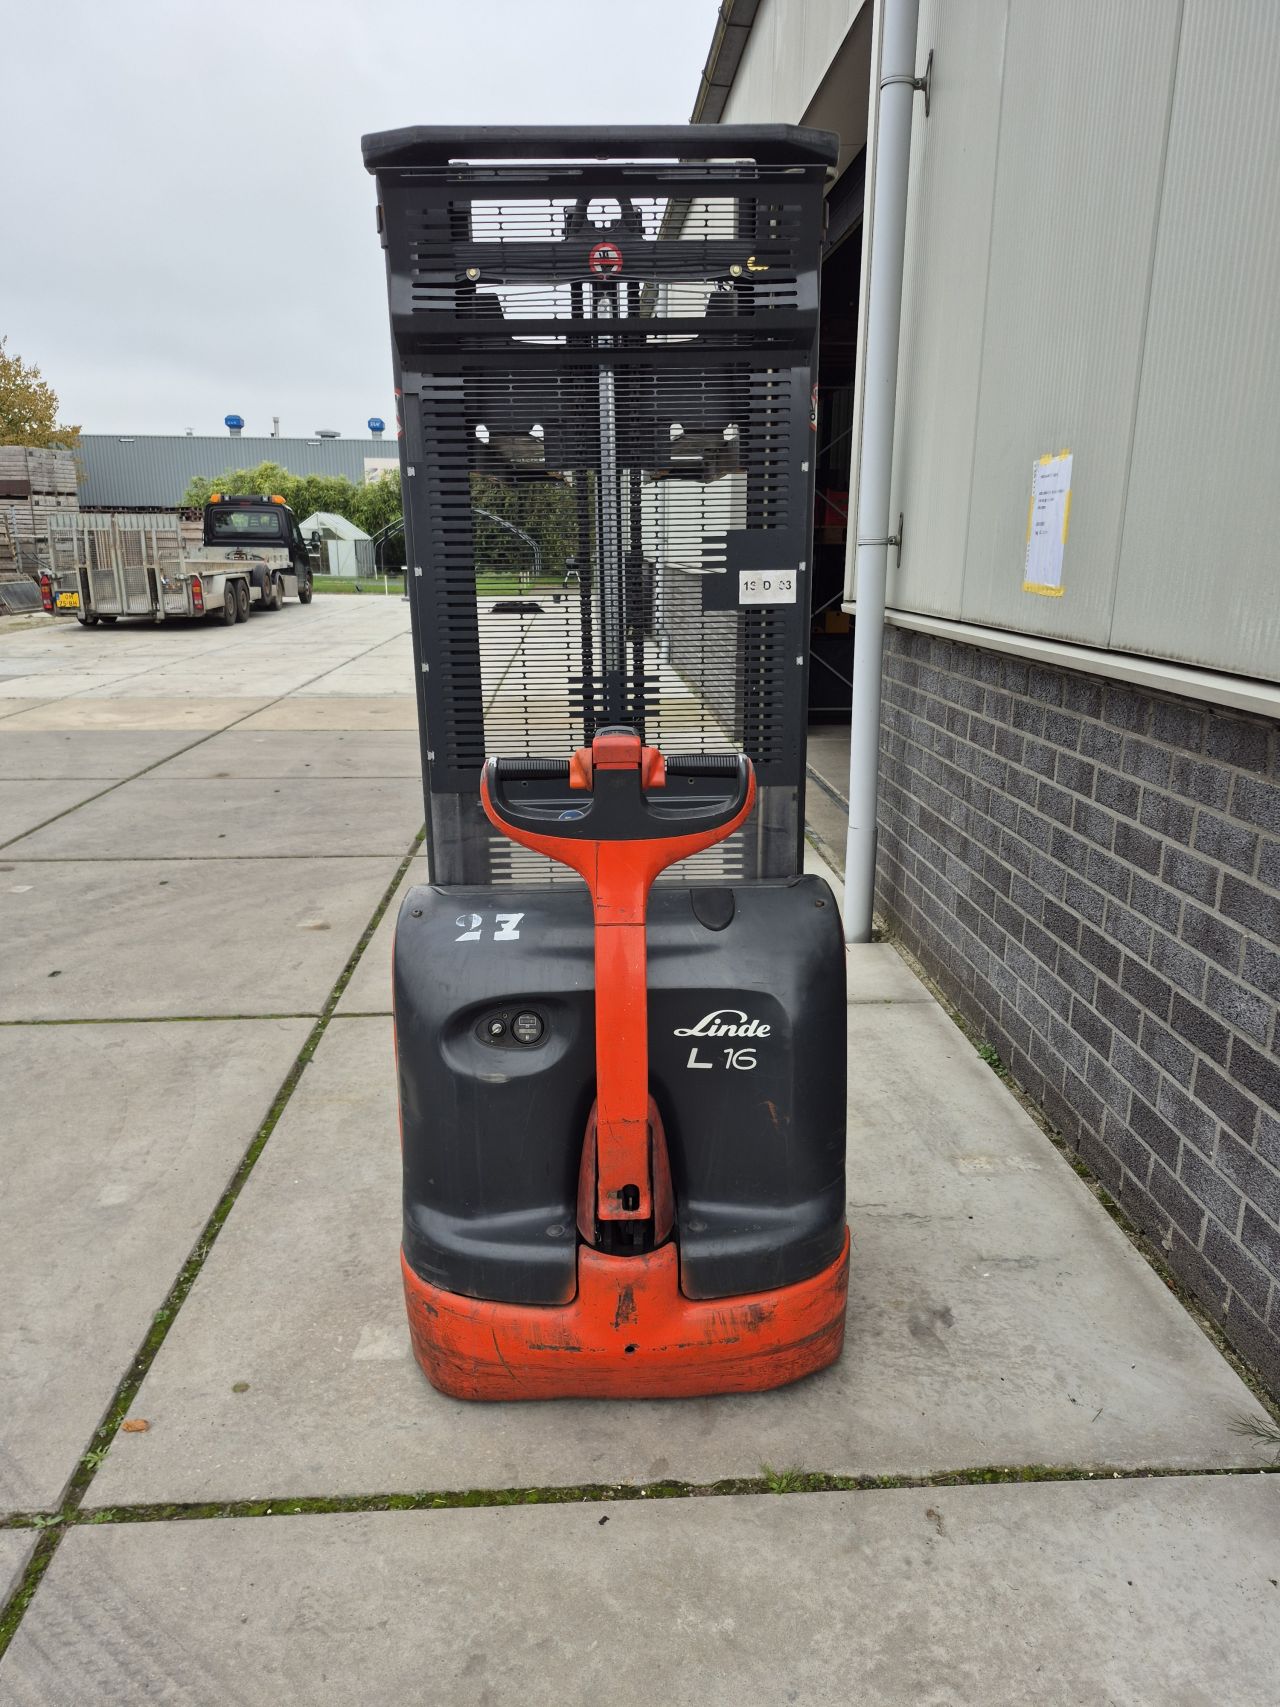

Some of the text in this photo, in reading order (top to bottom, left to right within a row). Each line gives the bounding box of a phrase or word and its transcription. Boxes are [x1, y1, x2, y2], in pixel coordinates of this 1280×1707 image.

[763, 580, 771, 591] D
[673, 1009, 771, 1038] Linde
[686, 1047, 758, 1071] L 16
